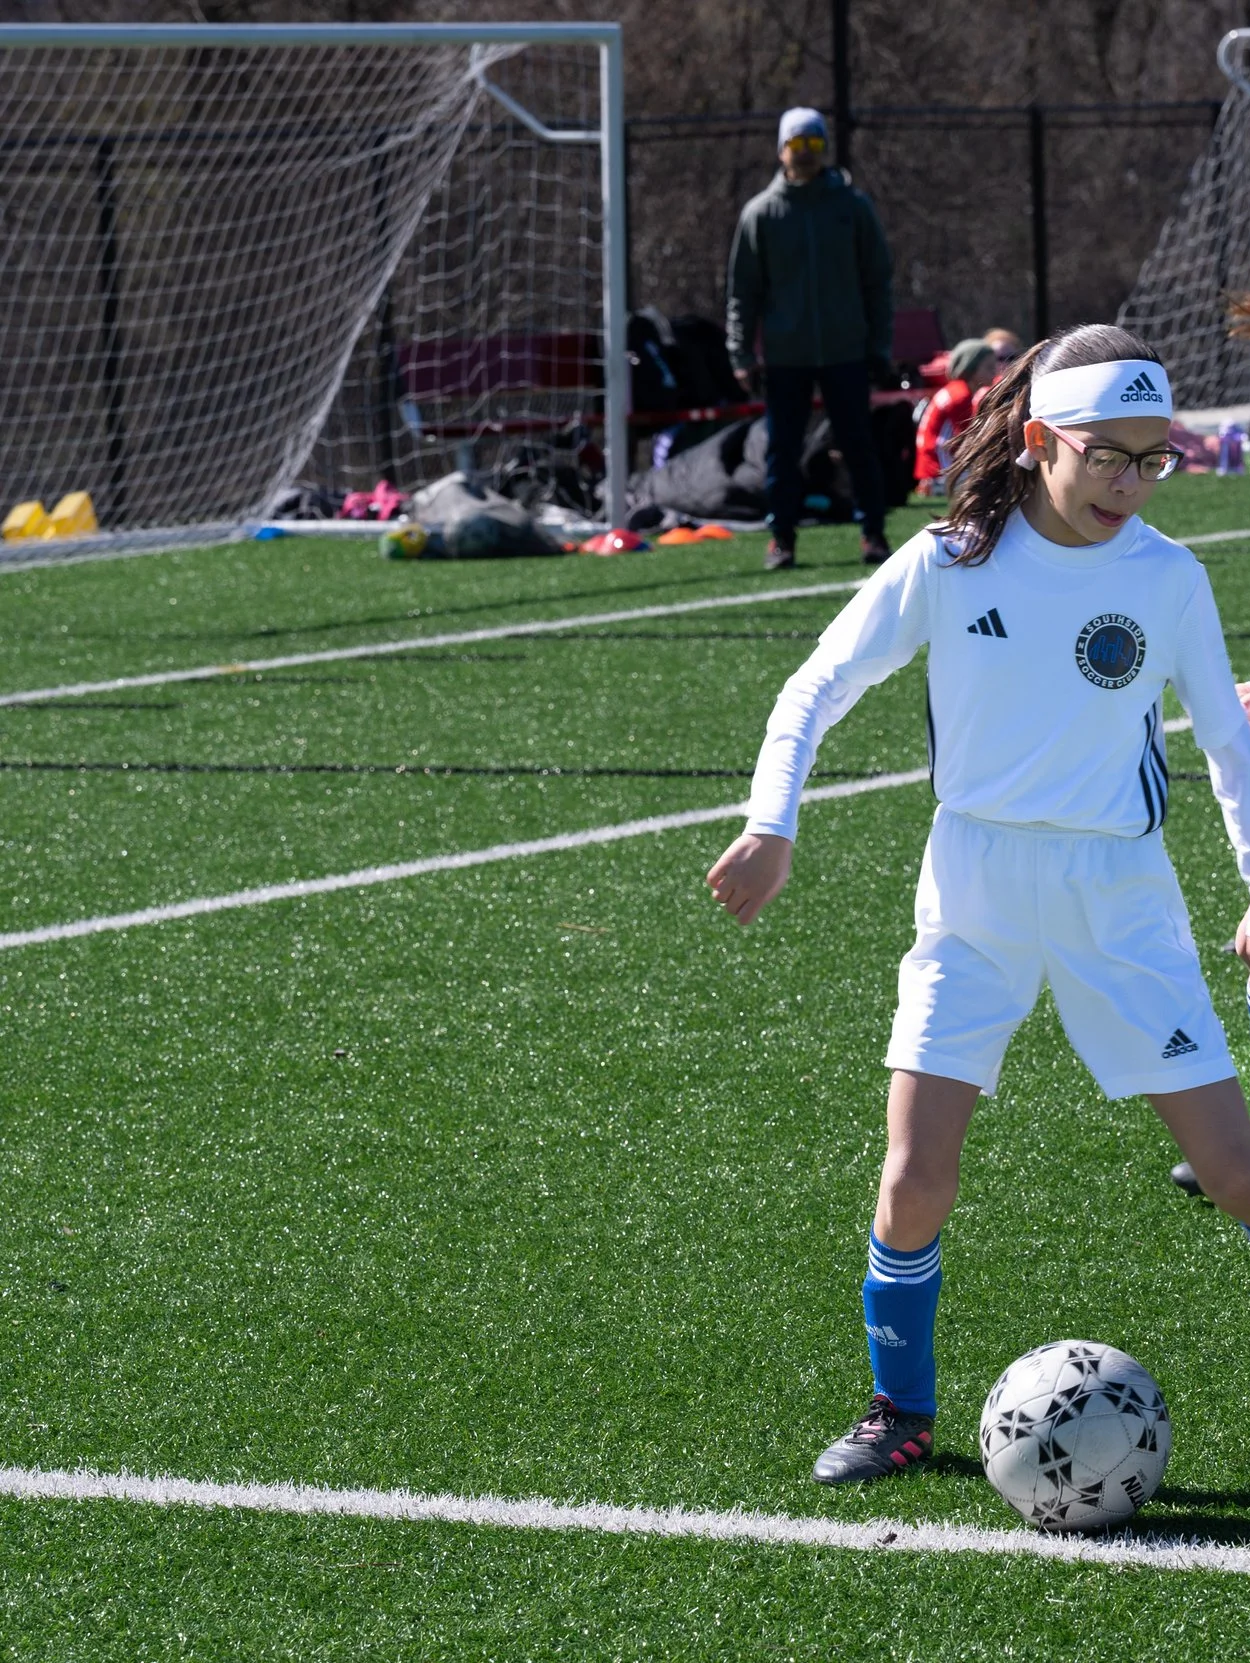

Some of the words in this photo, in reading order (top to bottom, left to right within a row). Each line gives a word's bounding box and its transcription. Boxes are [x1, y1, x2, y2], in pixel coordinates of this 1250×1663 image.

[1120, 389, 1163, 403] adidas
[1086, 614, 1145, 643] SOUTHSIDE
[1079, 659, 1114, 688] SOCCER
[1116, 670, 1137, 687] CLUB
[1162, 1042, 1198, 1059] adidas
